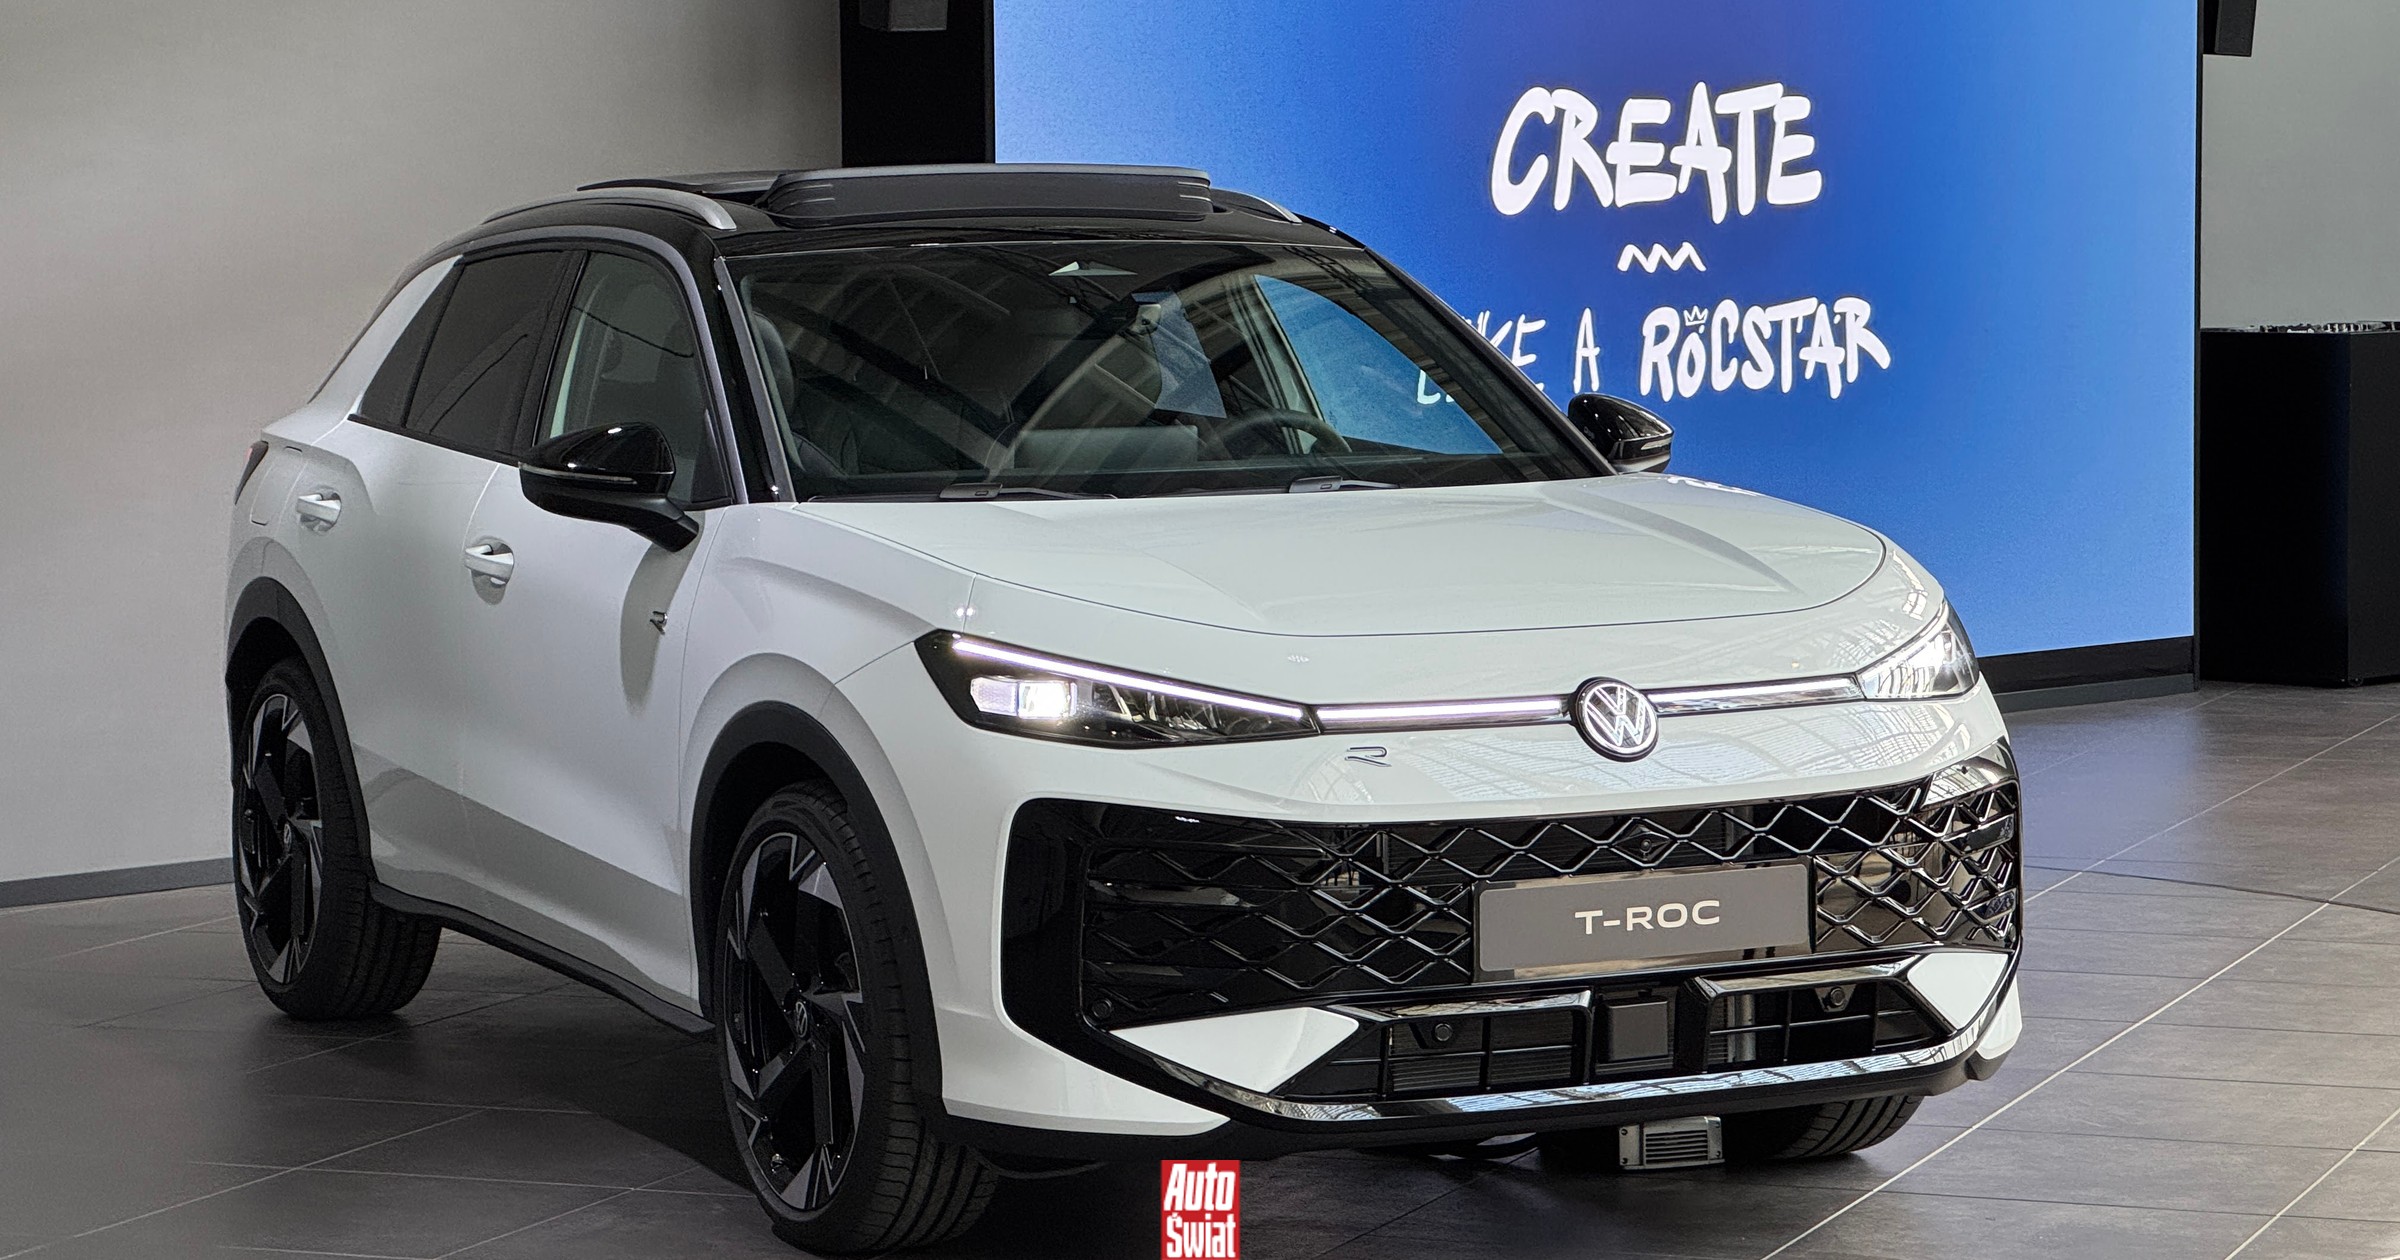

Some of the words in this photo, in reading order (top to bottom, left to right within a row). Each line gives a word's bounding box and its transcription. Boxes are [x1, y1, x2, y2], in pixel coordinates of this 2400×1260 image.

[1491, 81, 1823, 224] CREATE
[1572, 307, 1601, 395] A
[1574, 900, 1720, 935] T-ROC
